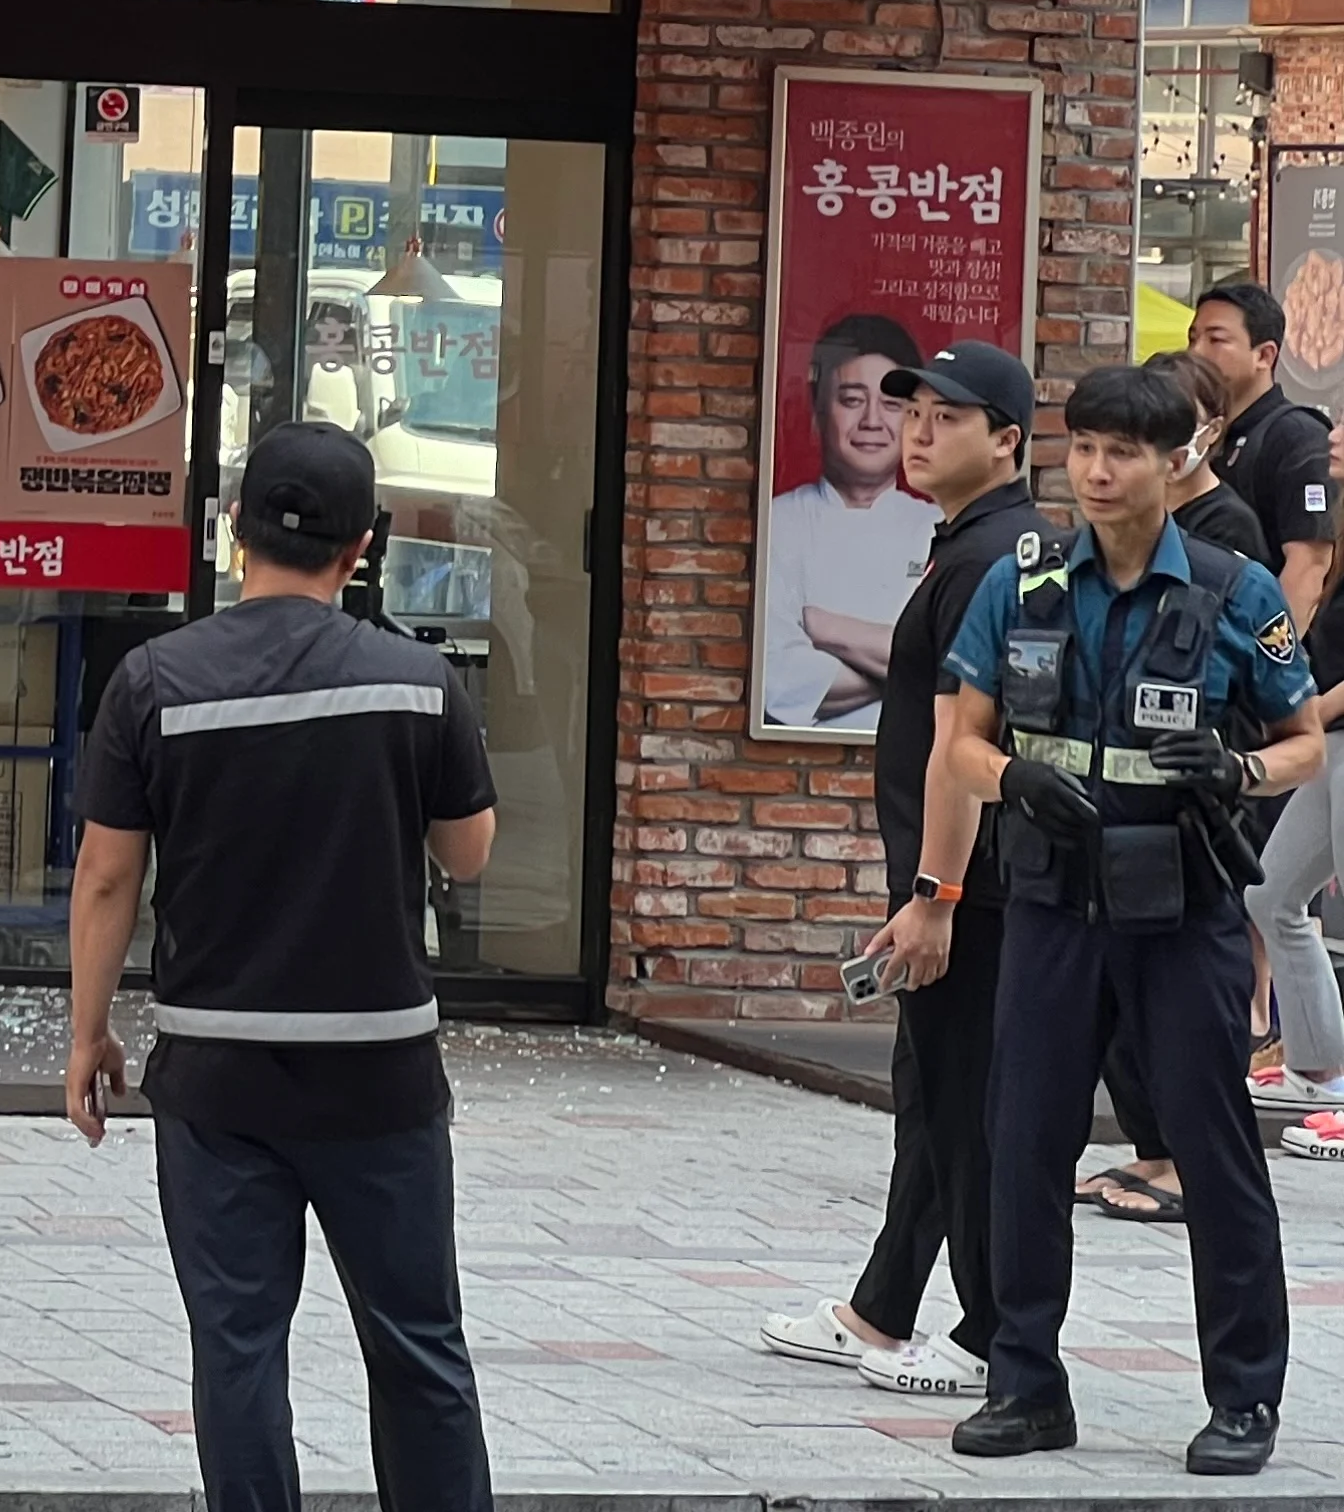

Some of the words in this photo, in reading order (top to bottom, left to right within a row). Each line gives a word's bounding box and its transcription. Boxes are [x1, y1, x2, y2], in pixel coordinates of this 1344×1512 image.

[810, 118, 905, 153] 백종원의
[802, 158, 1004, 225] 홍콩반점
[896, 1372, 959, 1394] crocs
